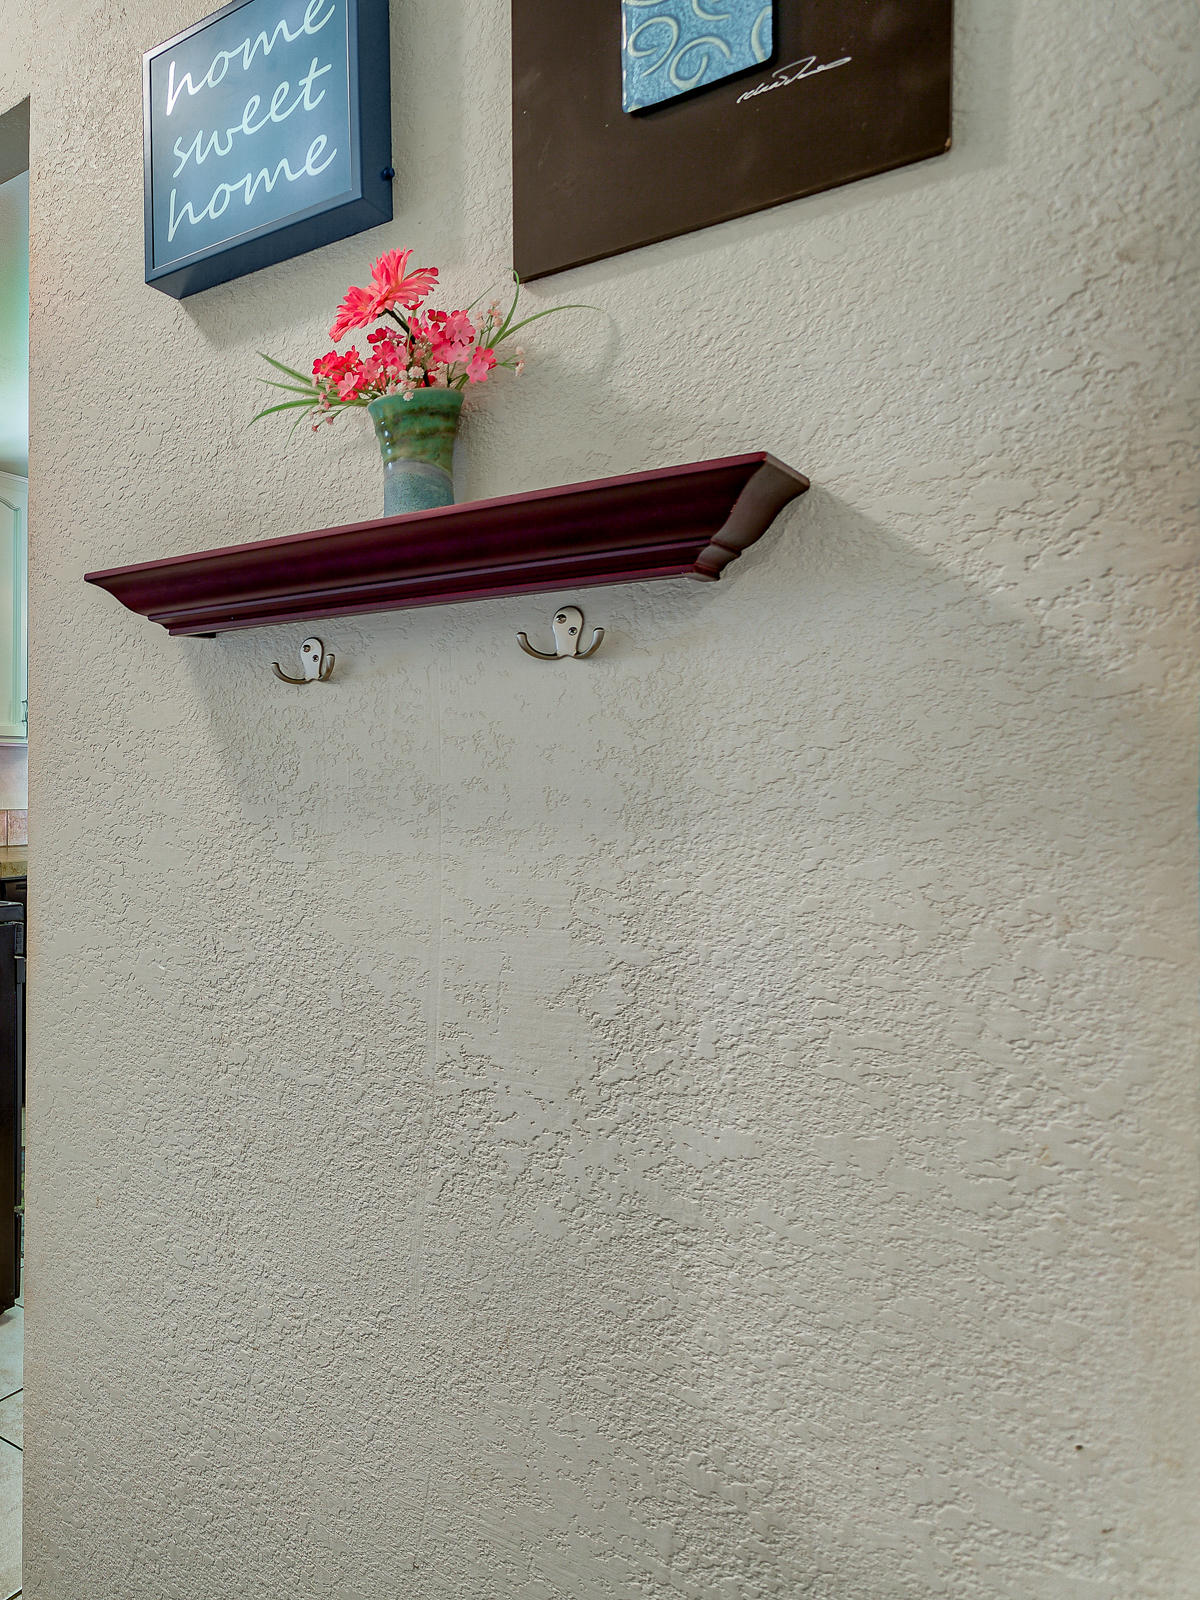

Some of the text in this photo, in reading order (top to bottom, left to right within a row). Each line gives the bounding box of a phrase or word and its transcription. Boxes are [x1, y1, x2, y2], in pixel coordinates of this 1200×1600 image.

[166, 0, 336, 116] home
[173, 57, 332, 178] sweet
[167, 134, 337, 242] home
